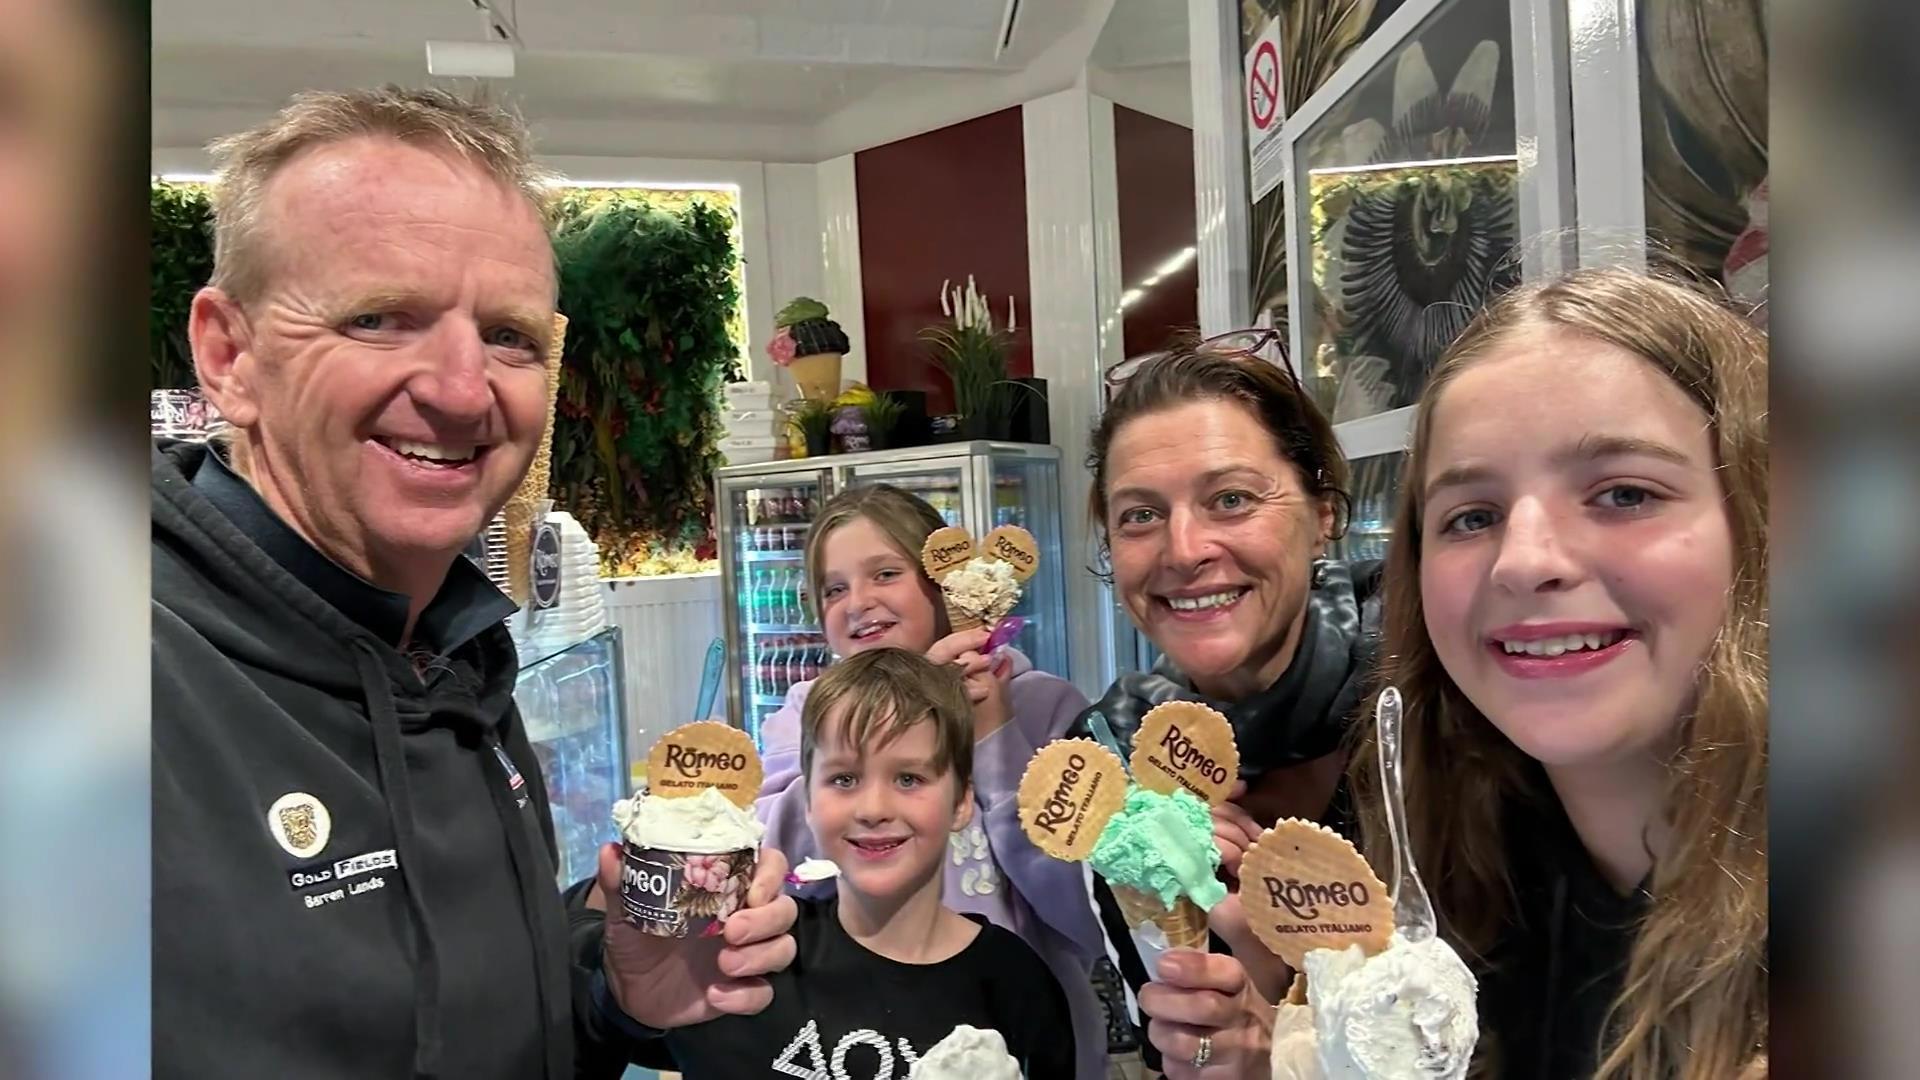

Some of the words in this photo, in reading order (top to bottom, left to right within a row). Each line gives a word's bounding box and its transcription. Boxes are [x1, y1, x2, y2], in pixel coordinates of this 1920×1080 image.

[660, 780, 695, 788] GELATO
[1148, 755, 1177, 778] GELATO
[1177, 775, 1209, 801] ITALIANO
[1066, 812, 1085, 846] GELATO
[1080, 771, 1103, 812] ITALIANO
[304, 889, 345, 908] Barren
[348, 877, 385, 895] Lands
[623, 864, 667, 896] meo
[1275, 925, 1317, 933] GELATO
[1320, 924, 1373, 933] ITALIANO
